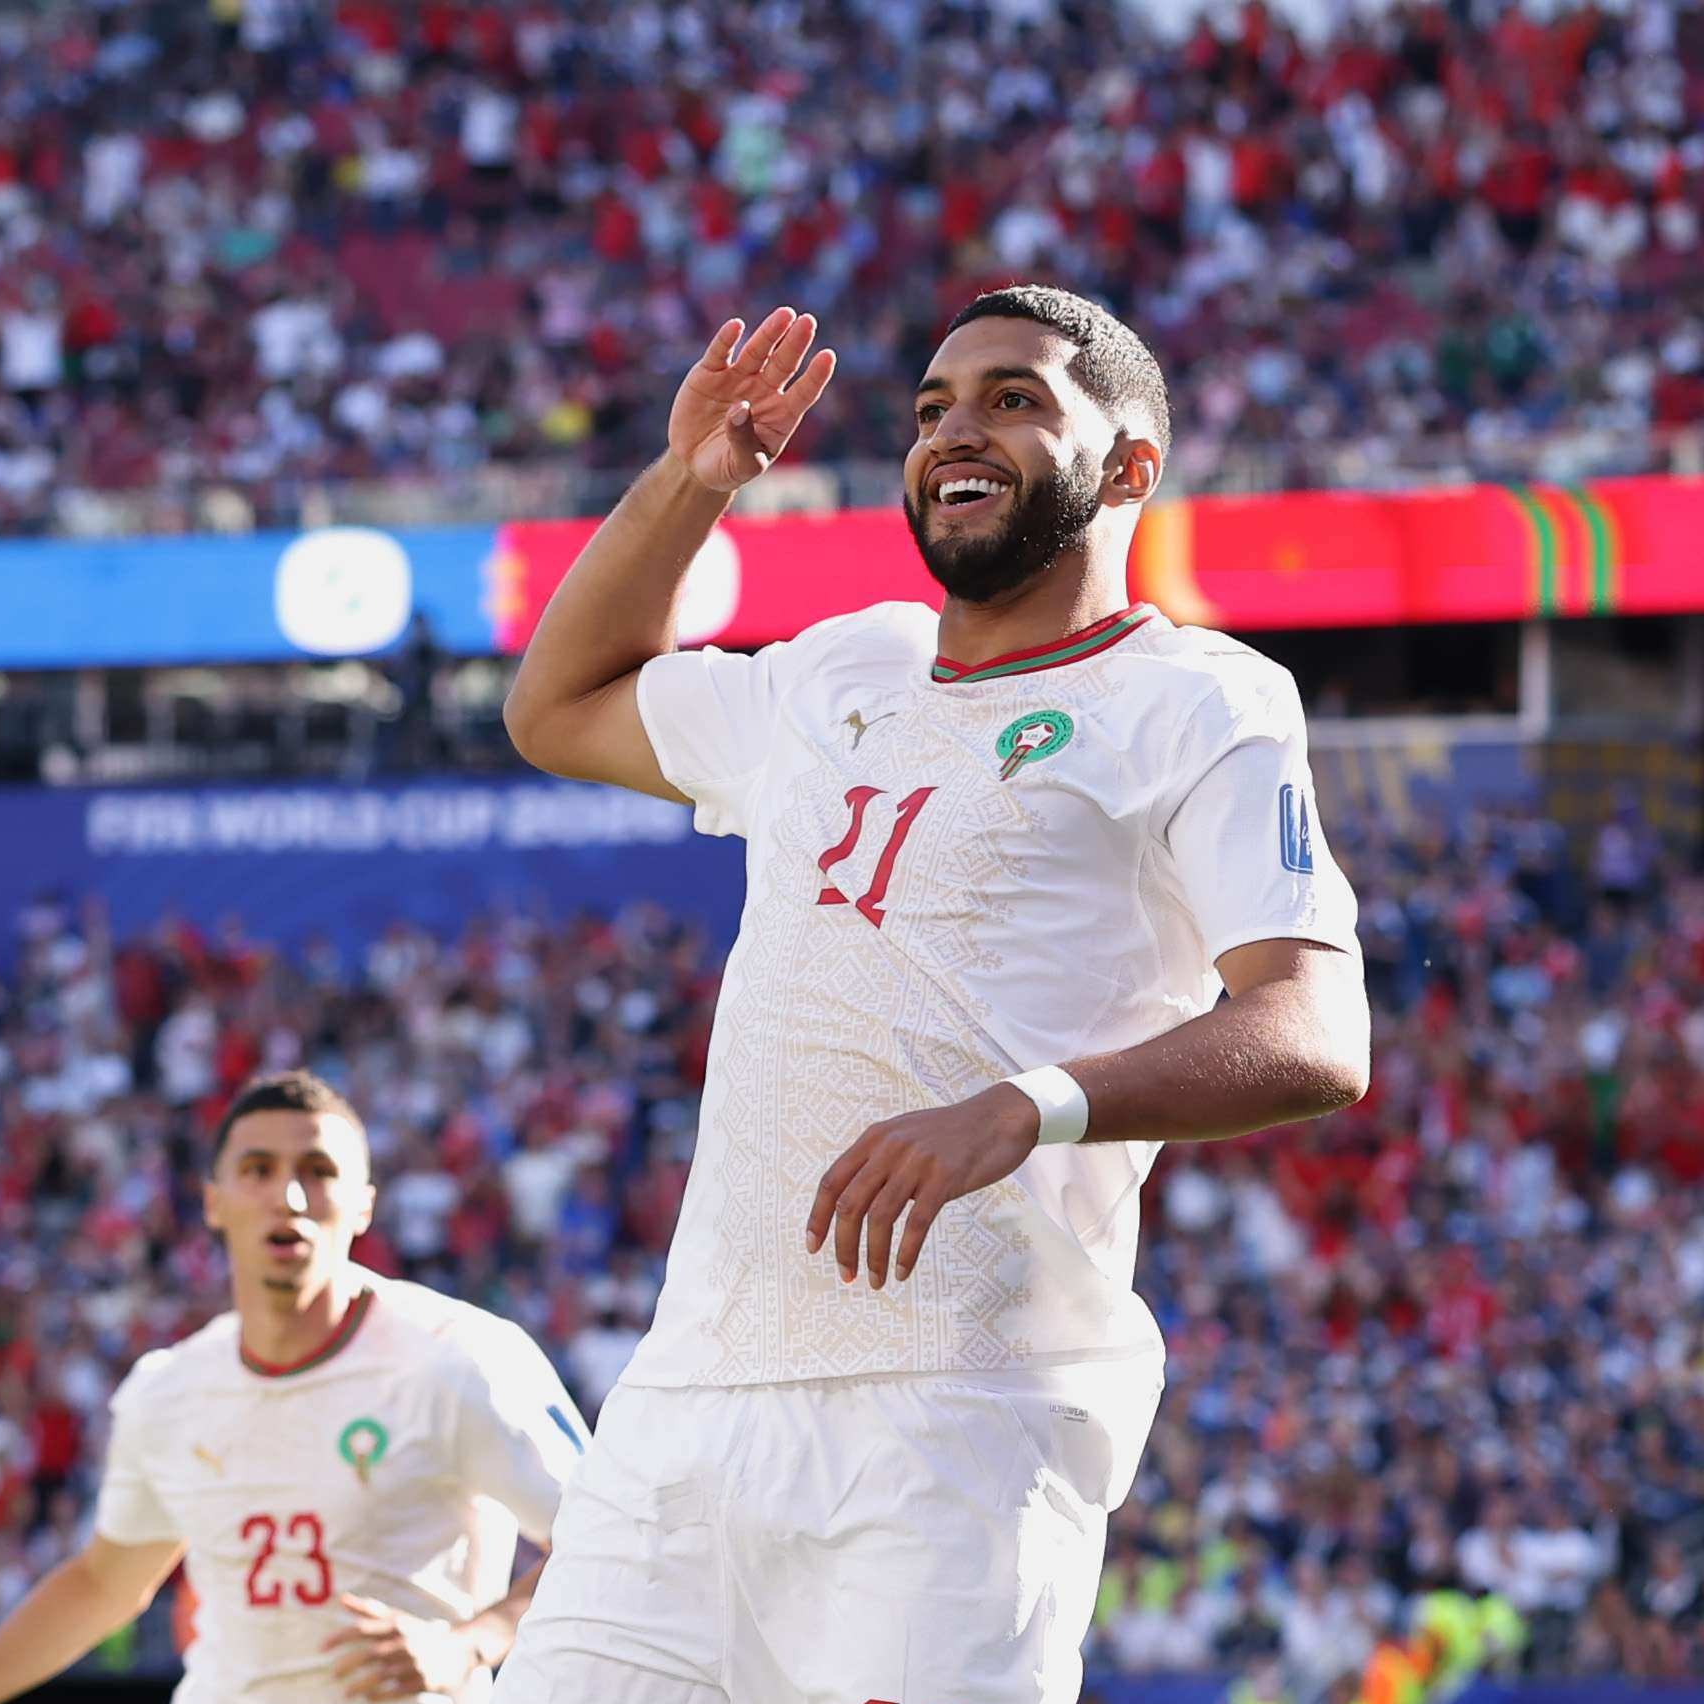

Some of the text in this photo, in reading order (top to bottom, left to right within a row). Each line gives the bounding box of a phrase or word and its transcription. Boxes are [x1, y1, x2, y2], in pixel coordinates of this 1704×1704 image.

[88, 795, 195, 853] FIFA
[207, 792, 383, 852] WORLD
[396, 789, 494, 850] CUP
[240, 1512, 334, 1608] 23
